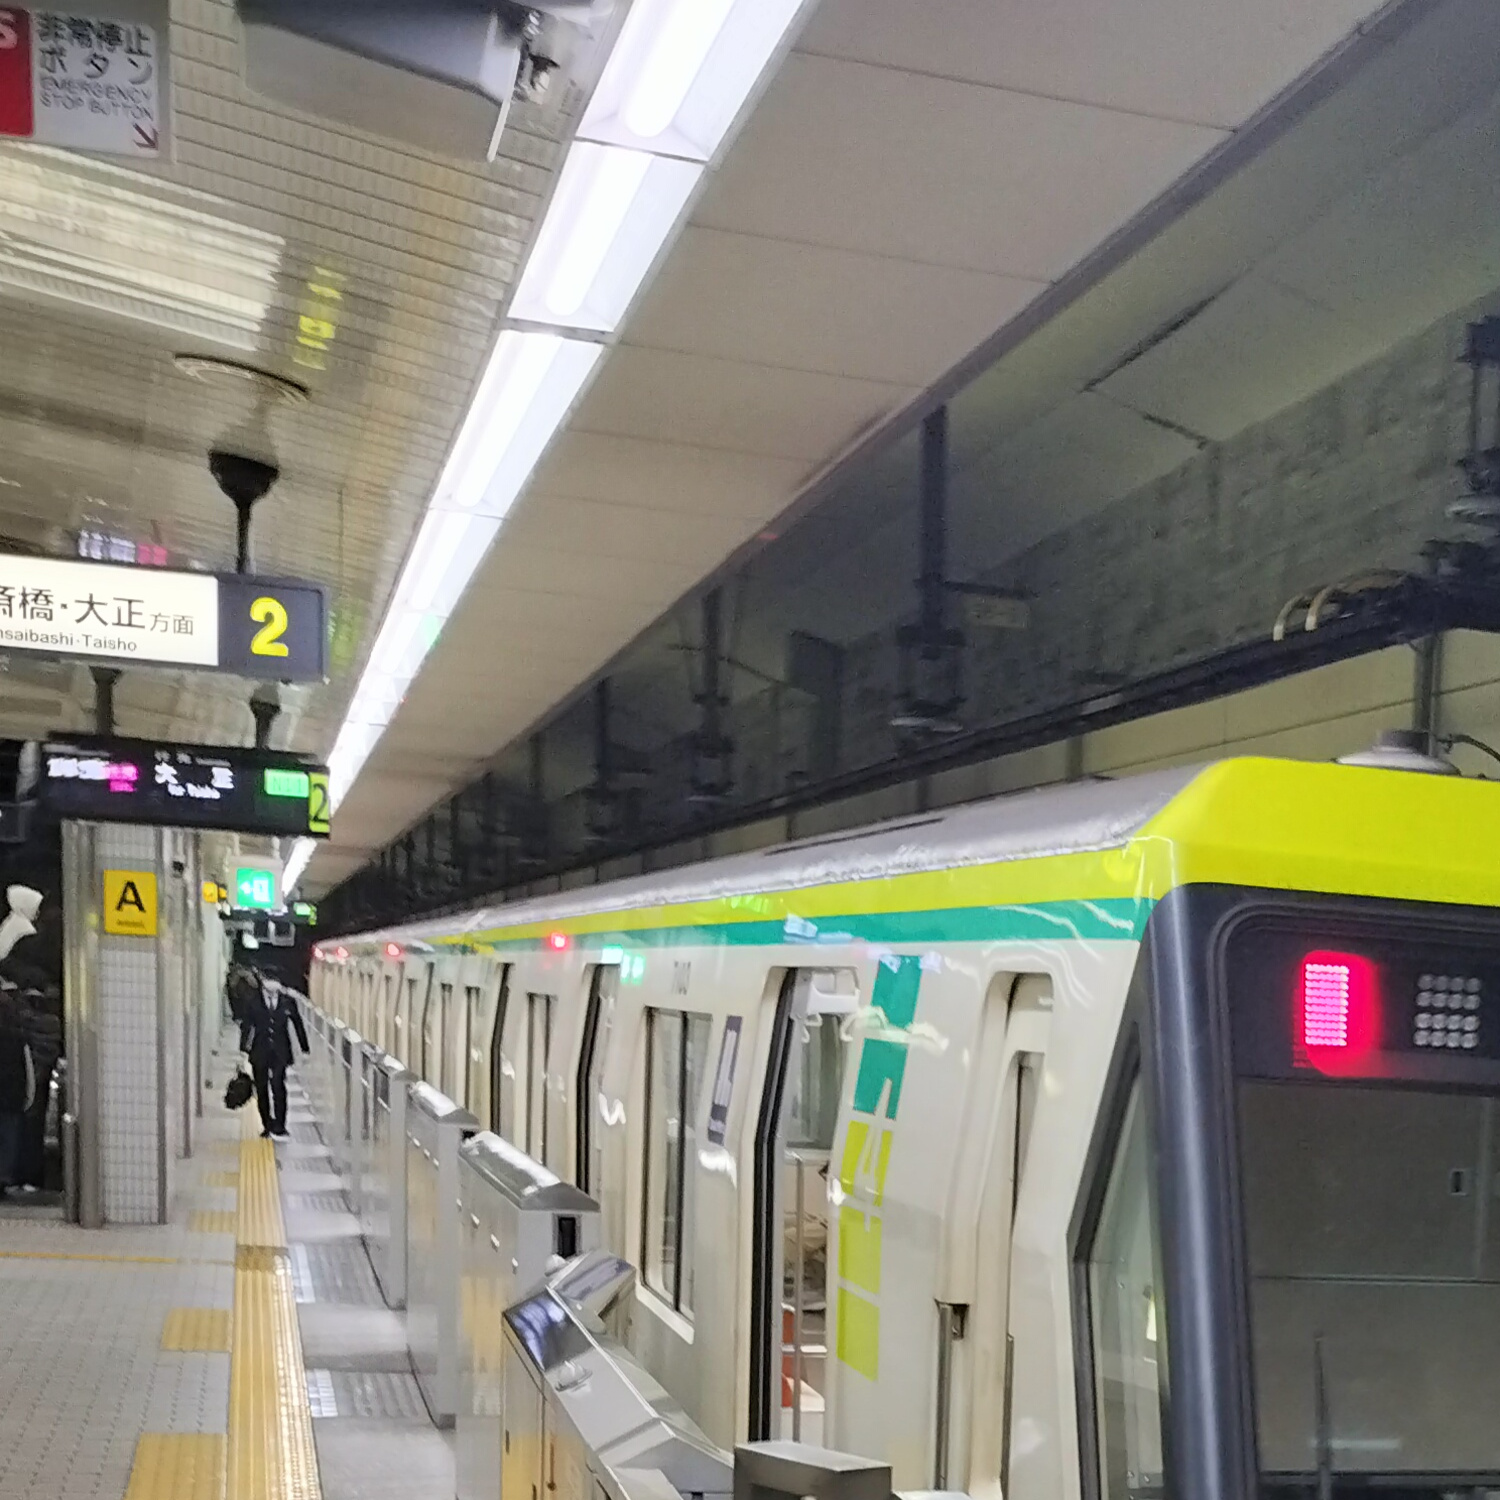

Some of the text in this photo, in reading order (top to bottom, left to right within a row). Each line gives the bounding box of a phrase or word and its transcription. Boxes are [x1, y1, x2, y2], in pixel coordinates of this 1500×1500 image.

[250, 596, 289, 657] 2
[311, 781, 330, 823] 2
[115, 879, 147, 914] A
